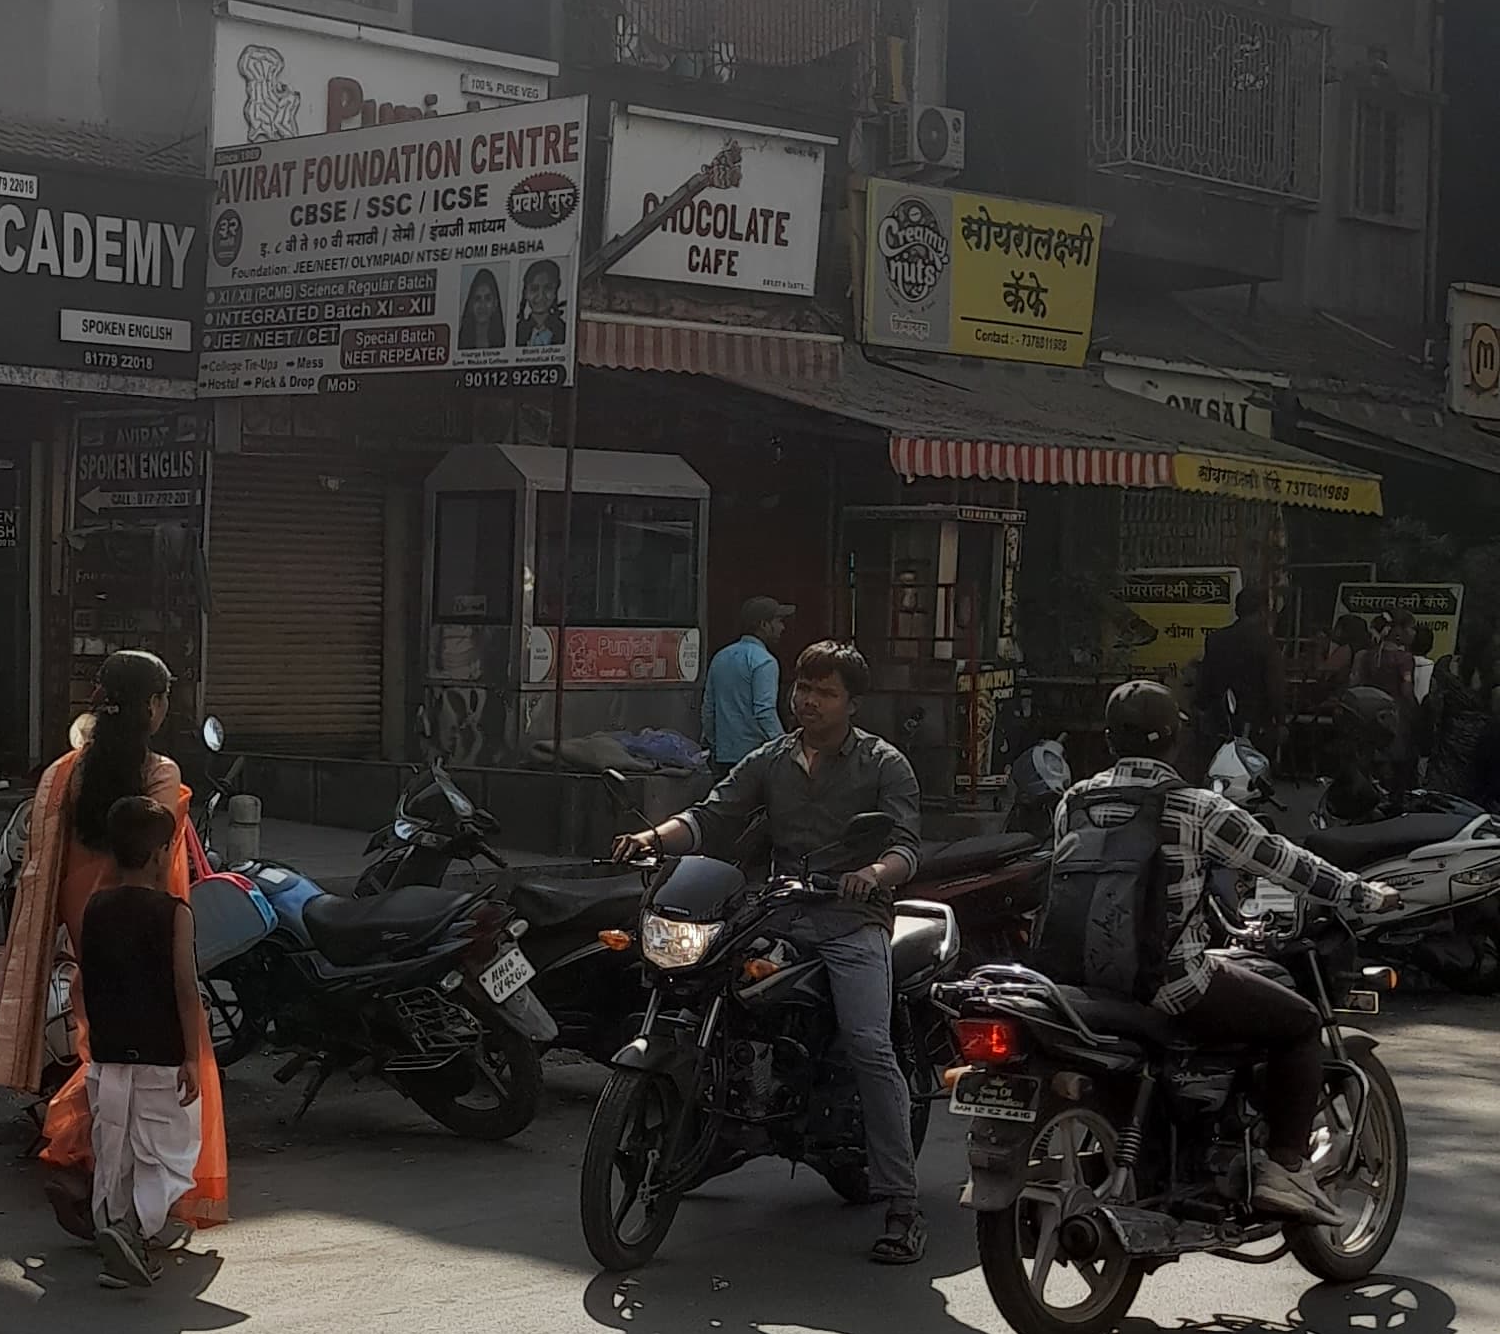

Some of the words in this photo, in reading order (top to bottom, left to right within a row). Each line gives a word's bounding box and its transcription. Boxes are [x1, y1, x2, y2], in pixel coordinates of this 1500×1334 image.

[496, 83, 520, 97] PURE
[522, 87, 540, 100] VEG
[215, 160, 298, 205] AVIRAT
[302, 137, 462, 196] FOUNDATION
[471, 121, 580, 175] CENTRE
[290, 200, 348, 227] CBSE
[366, 192, 412, 219] SSC
[433, 183, 489, 212] ICSE
[512, 183, 545, 214] प्रवेश
[346, 225, 378, 247] मराठी
[878, 216, 949, 259] Creamy
[455, 244, 488, 260] HOMI
[491, 239, 545, 257] BHABHA
[688, 245, 739, 277] CAFE
[889, 257, 936, 289] nuts
[300, 281, 344, 298] Science
[348, 277, 395, 297] Regular
[398, 274, 434, 291] Batch
[1002, 270, 1049, 319] कॅफे
[216, 305, 319, 326] INTEGRATED
[324, 303, 372, 320] Batch
[376, 300, 394, 316] XI
[408, 297, 432, 314] XII
[80, 318, 126, 339] SPOKEN
[127, 322, 173, 342] ENGLISH
[214, 334, 242, 350] JEE
[253, 330, 294, 347] NEET
[307, 327, 339, 344] CET
[355, 330, 398, 347] Special
[401, 327, 436, 343] Batch
[975, 328, 1009, 344] Contact
[84, 351, 119, 368] 81779
[120, 354, 154, 371] 22018
[297, 357, 324, 369] Mess
[344, 350, 379, 365] NEET
[380, 345, 447, 364] REPEATER
[254, 375, 276, 389] Pick
[289, 374, 315, 390] Drop
[465, 372, 508, 388] 90112
[512, 369, 559, 386] 92629
[1206, 398, 1250, 431] SAI
[79, 453, 137, 481] SPOKEN
